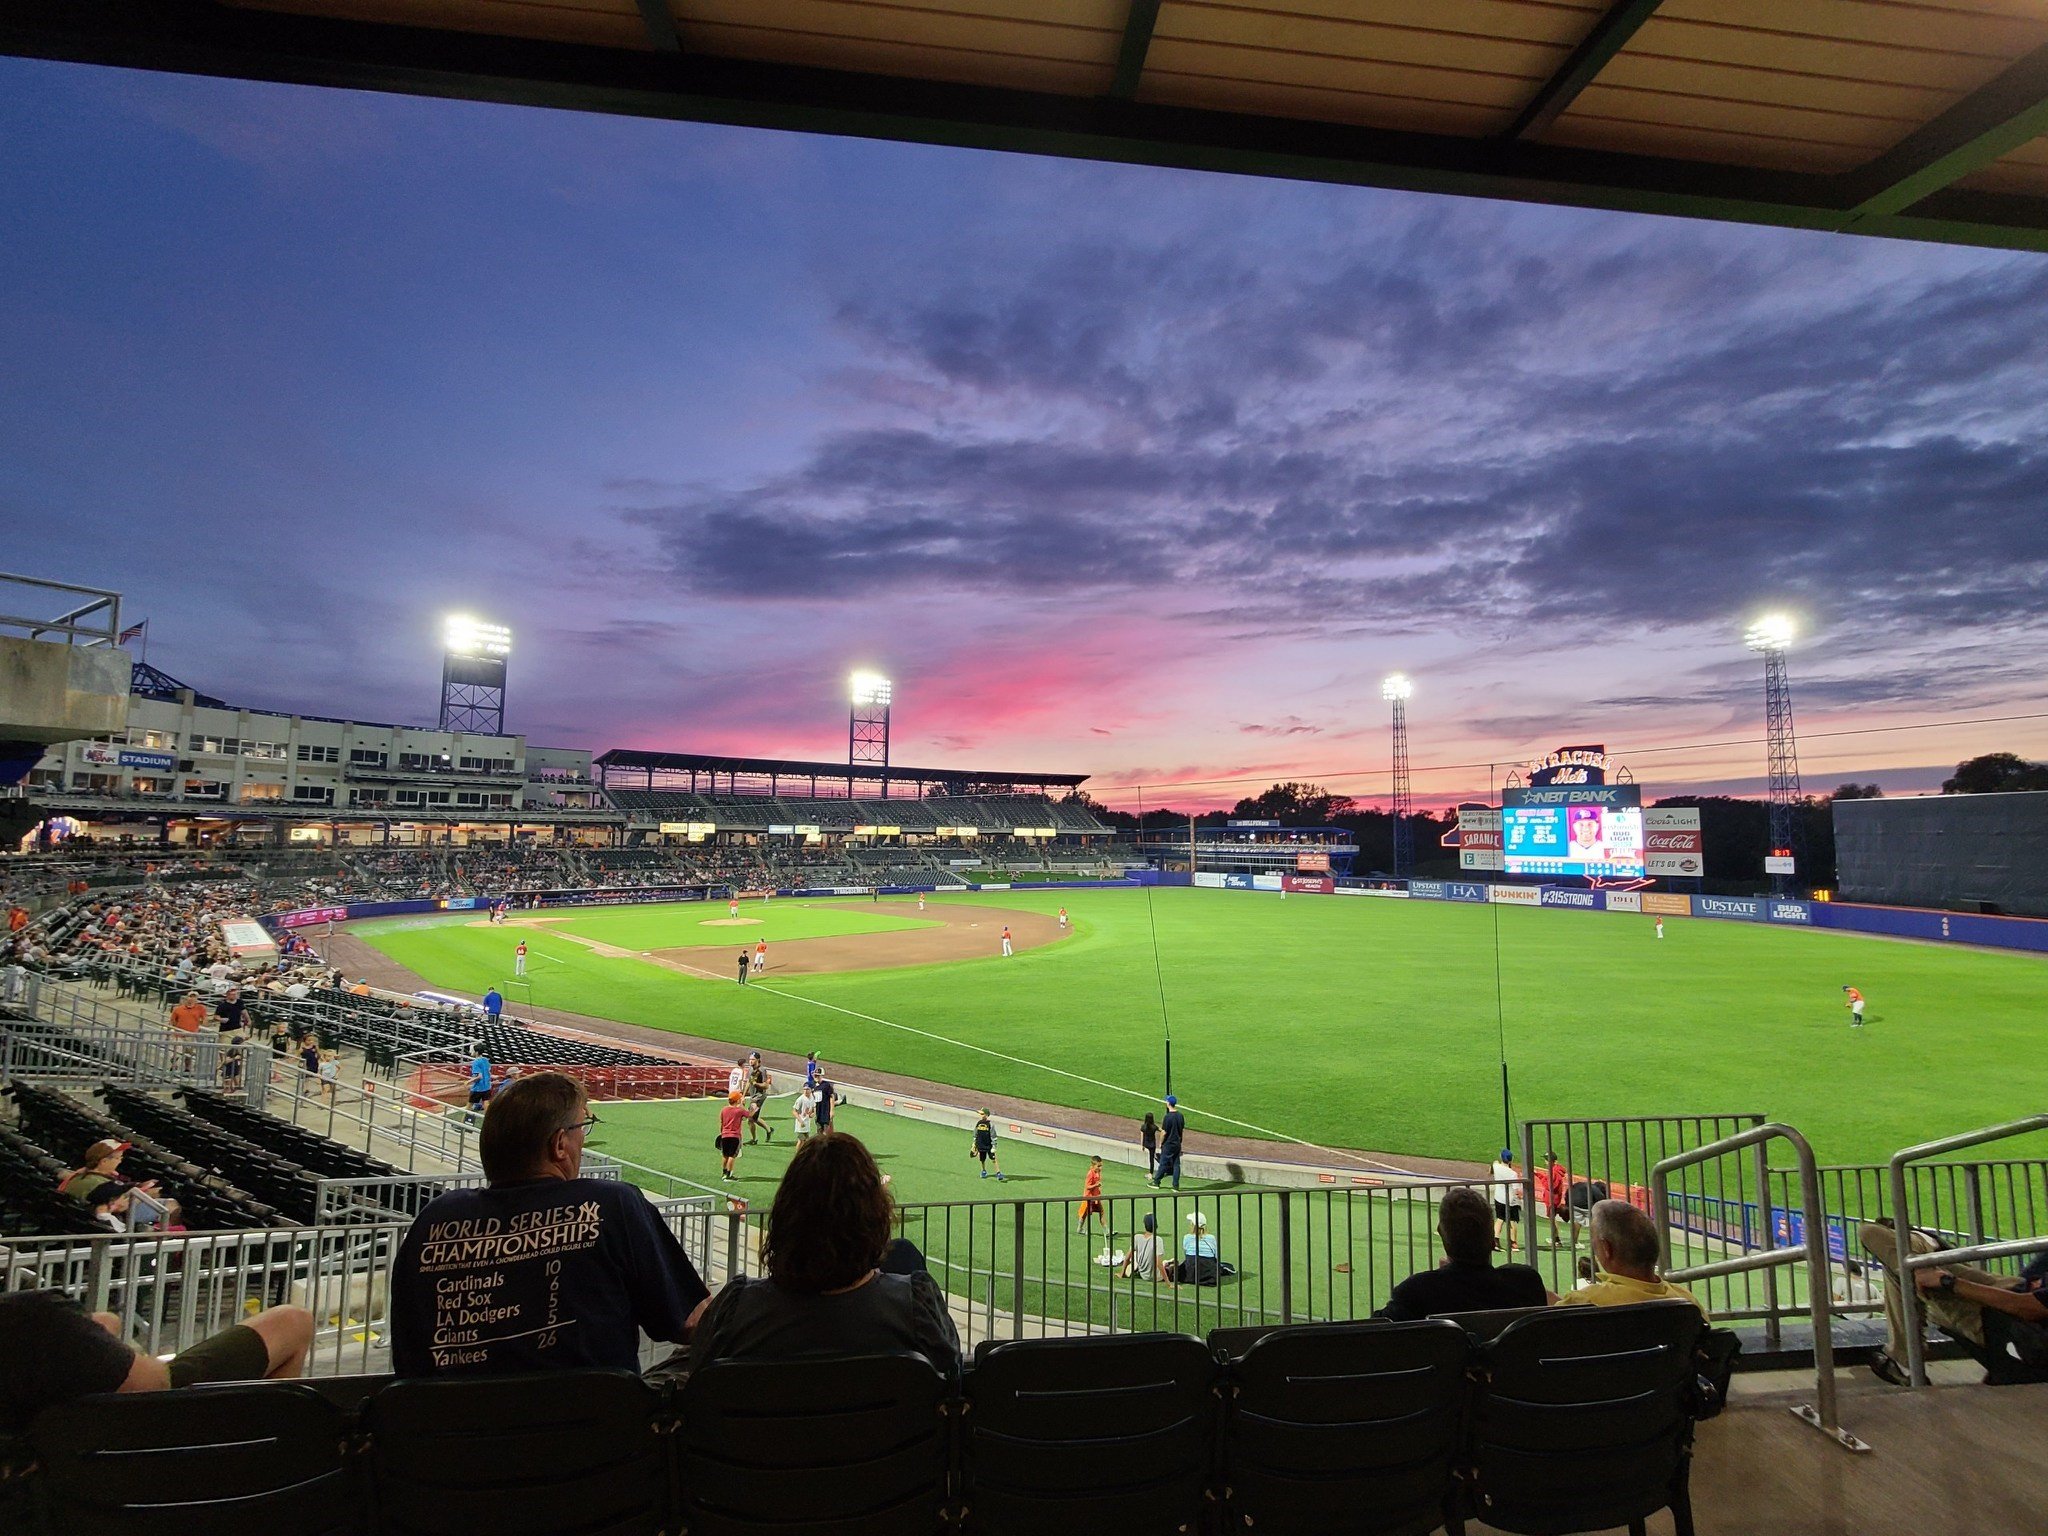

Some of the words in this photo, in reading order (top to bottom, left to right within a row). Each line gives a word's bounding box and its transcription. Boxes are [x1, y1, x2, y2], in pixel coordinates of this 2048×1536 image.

[121, 755, 171, 766] STADIUM
[1530, 750, 1614, 774] SYRACUSE
[1550, 767, 1588, 785] Mets
[1536, 791, 1568, 803] NBT
[1568, 790, 1617, 802] BANK
[1645, 817, 1670, 825] Coors
[1464, 833, 1499, 847] SARANAC
[1647, 860, 1666, 868] LET'S
[1666, 860, 1676, 868] GO
[1412, 881, 1441, 890] UPSTATE
[1542, 890, 1595, 906] #315STRONG
[1702, 899, 1757, 913] UPSTATE
[1773, 911, 1808, 920] LIGHT
[1777, 904, 1803, 912] BUD
[428, 1217, 501, 1242] WORLD
[509, 1205, 575, 1234] SERIES
[419, 1222, 600, 1265] CHAMPIONSHIPS
[472, 1260, 489, 1268] EVEN
[540, 1246, 561, 1256] COULD
[561, 1243, 582, 1252] FIGURE
[582, 1240, 596, 1248] OUT
[436, 1271, 504, 1294] Cardinals
[545, 1259, 562, 1277] 10
[437, 1294, 462, 1310] Red
[467, 1292, 492, 1307] Sox
[550, 1276, 559, 1292] 6
[436, 1311, 455, 1328] LA
[459, 1303, 520, 1323] Dodgers
[549, 1292, 558, 1308] 5
[433, 1328, 478, 1345] Giants
[547, 1308, 557, 1325] 5
[432, 1349, 488, 1368] Yankees
[537, 1330, 557, 1350] 26
